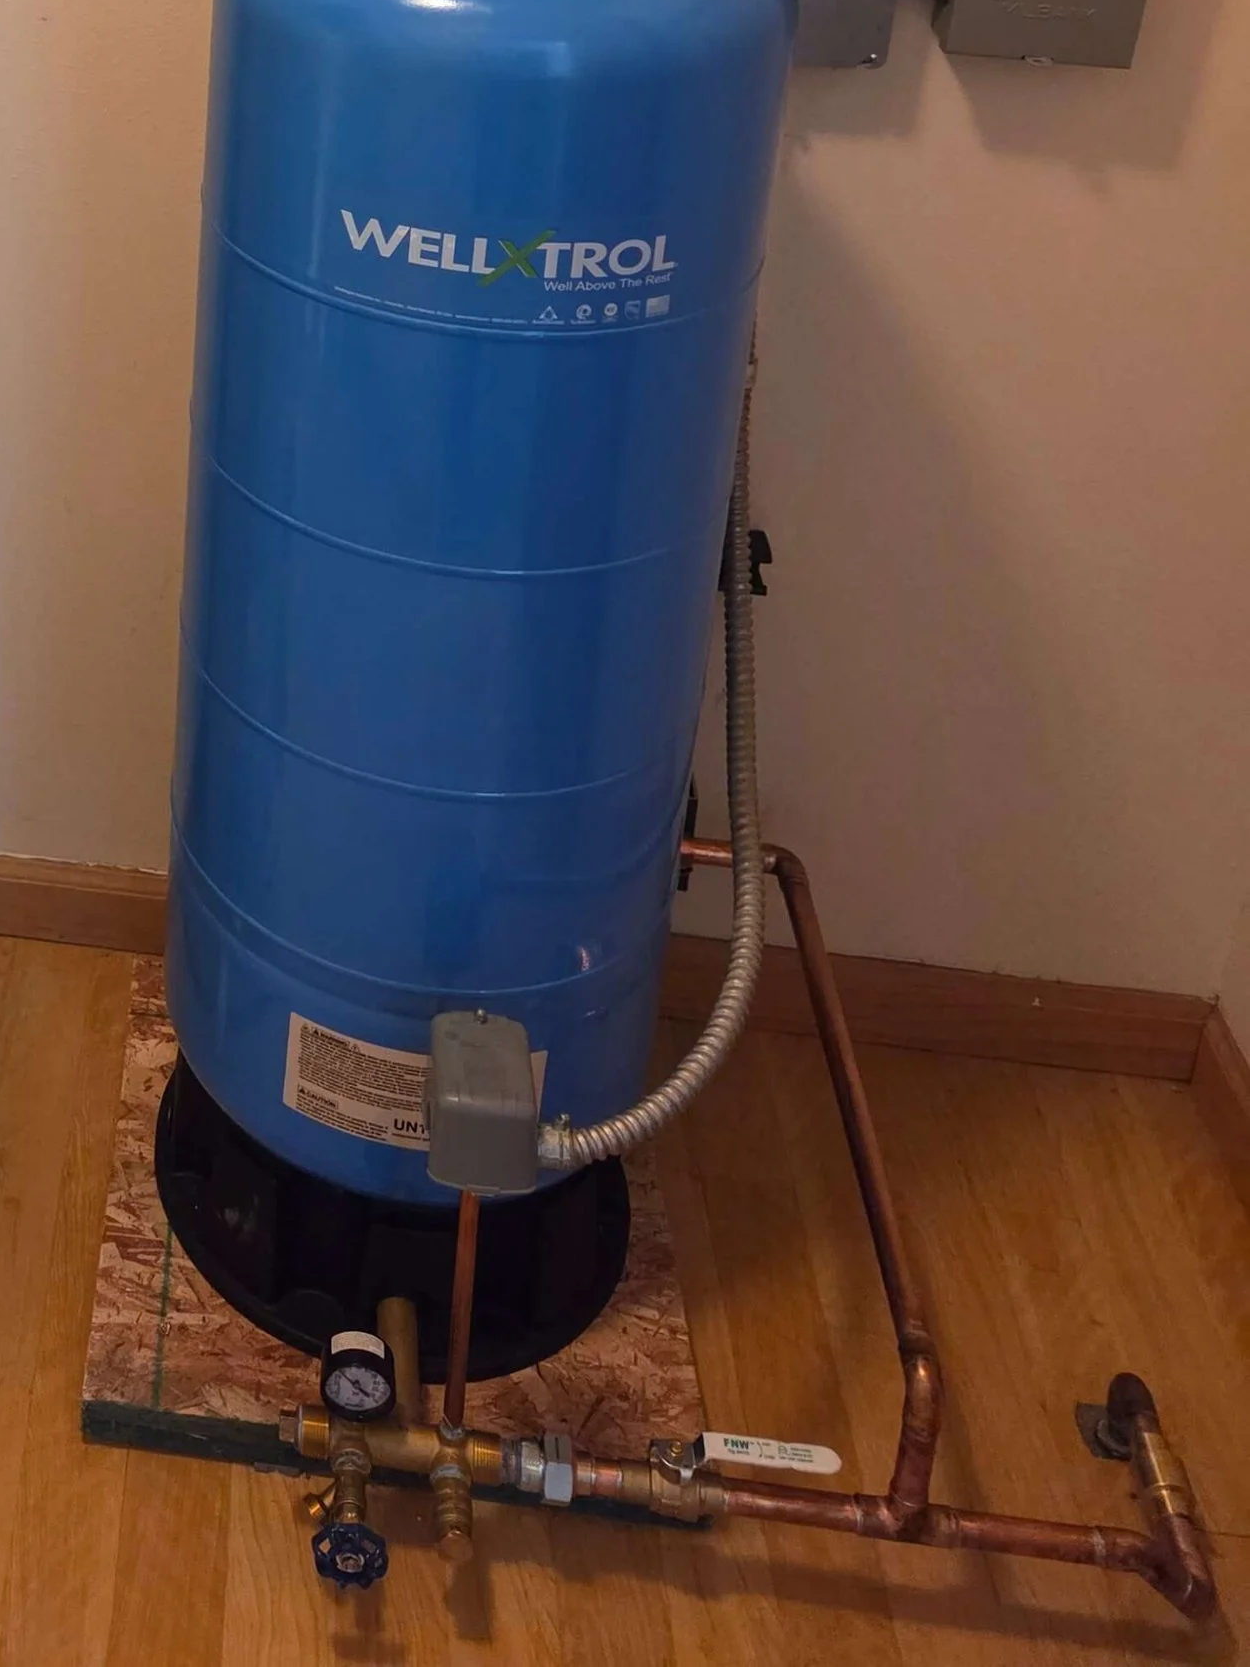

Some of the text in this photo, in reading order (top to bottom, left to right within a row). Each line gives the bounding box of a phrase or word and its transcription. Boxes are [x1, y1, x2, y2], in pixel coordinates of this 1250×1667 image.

[543, 272, 673, 293] Well Above The Rest
[305, 1090, 337, 1109] CAUTION
[723, 1438, 749, 1450] FNW
